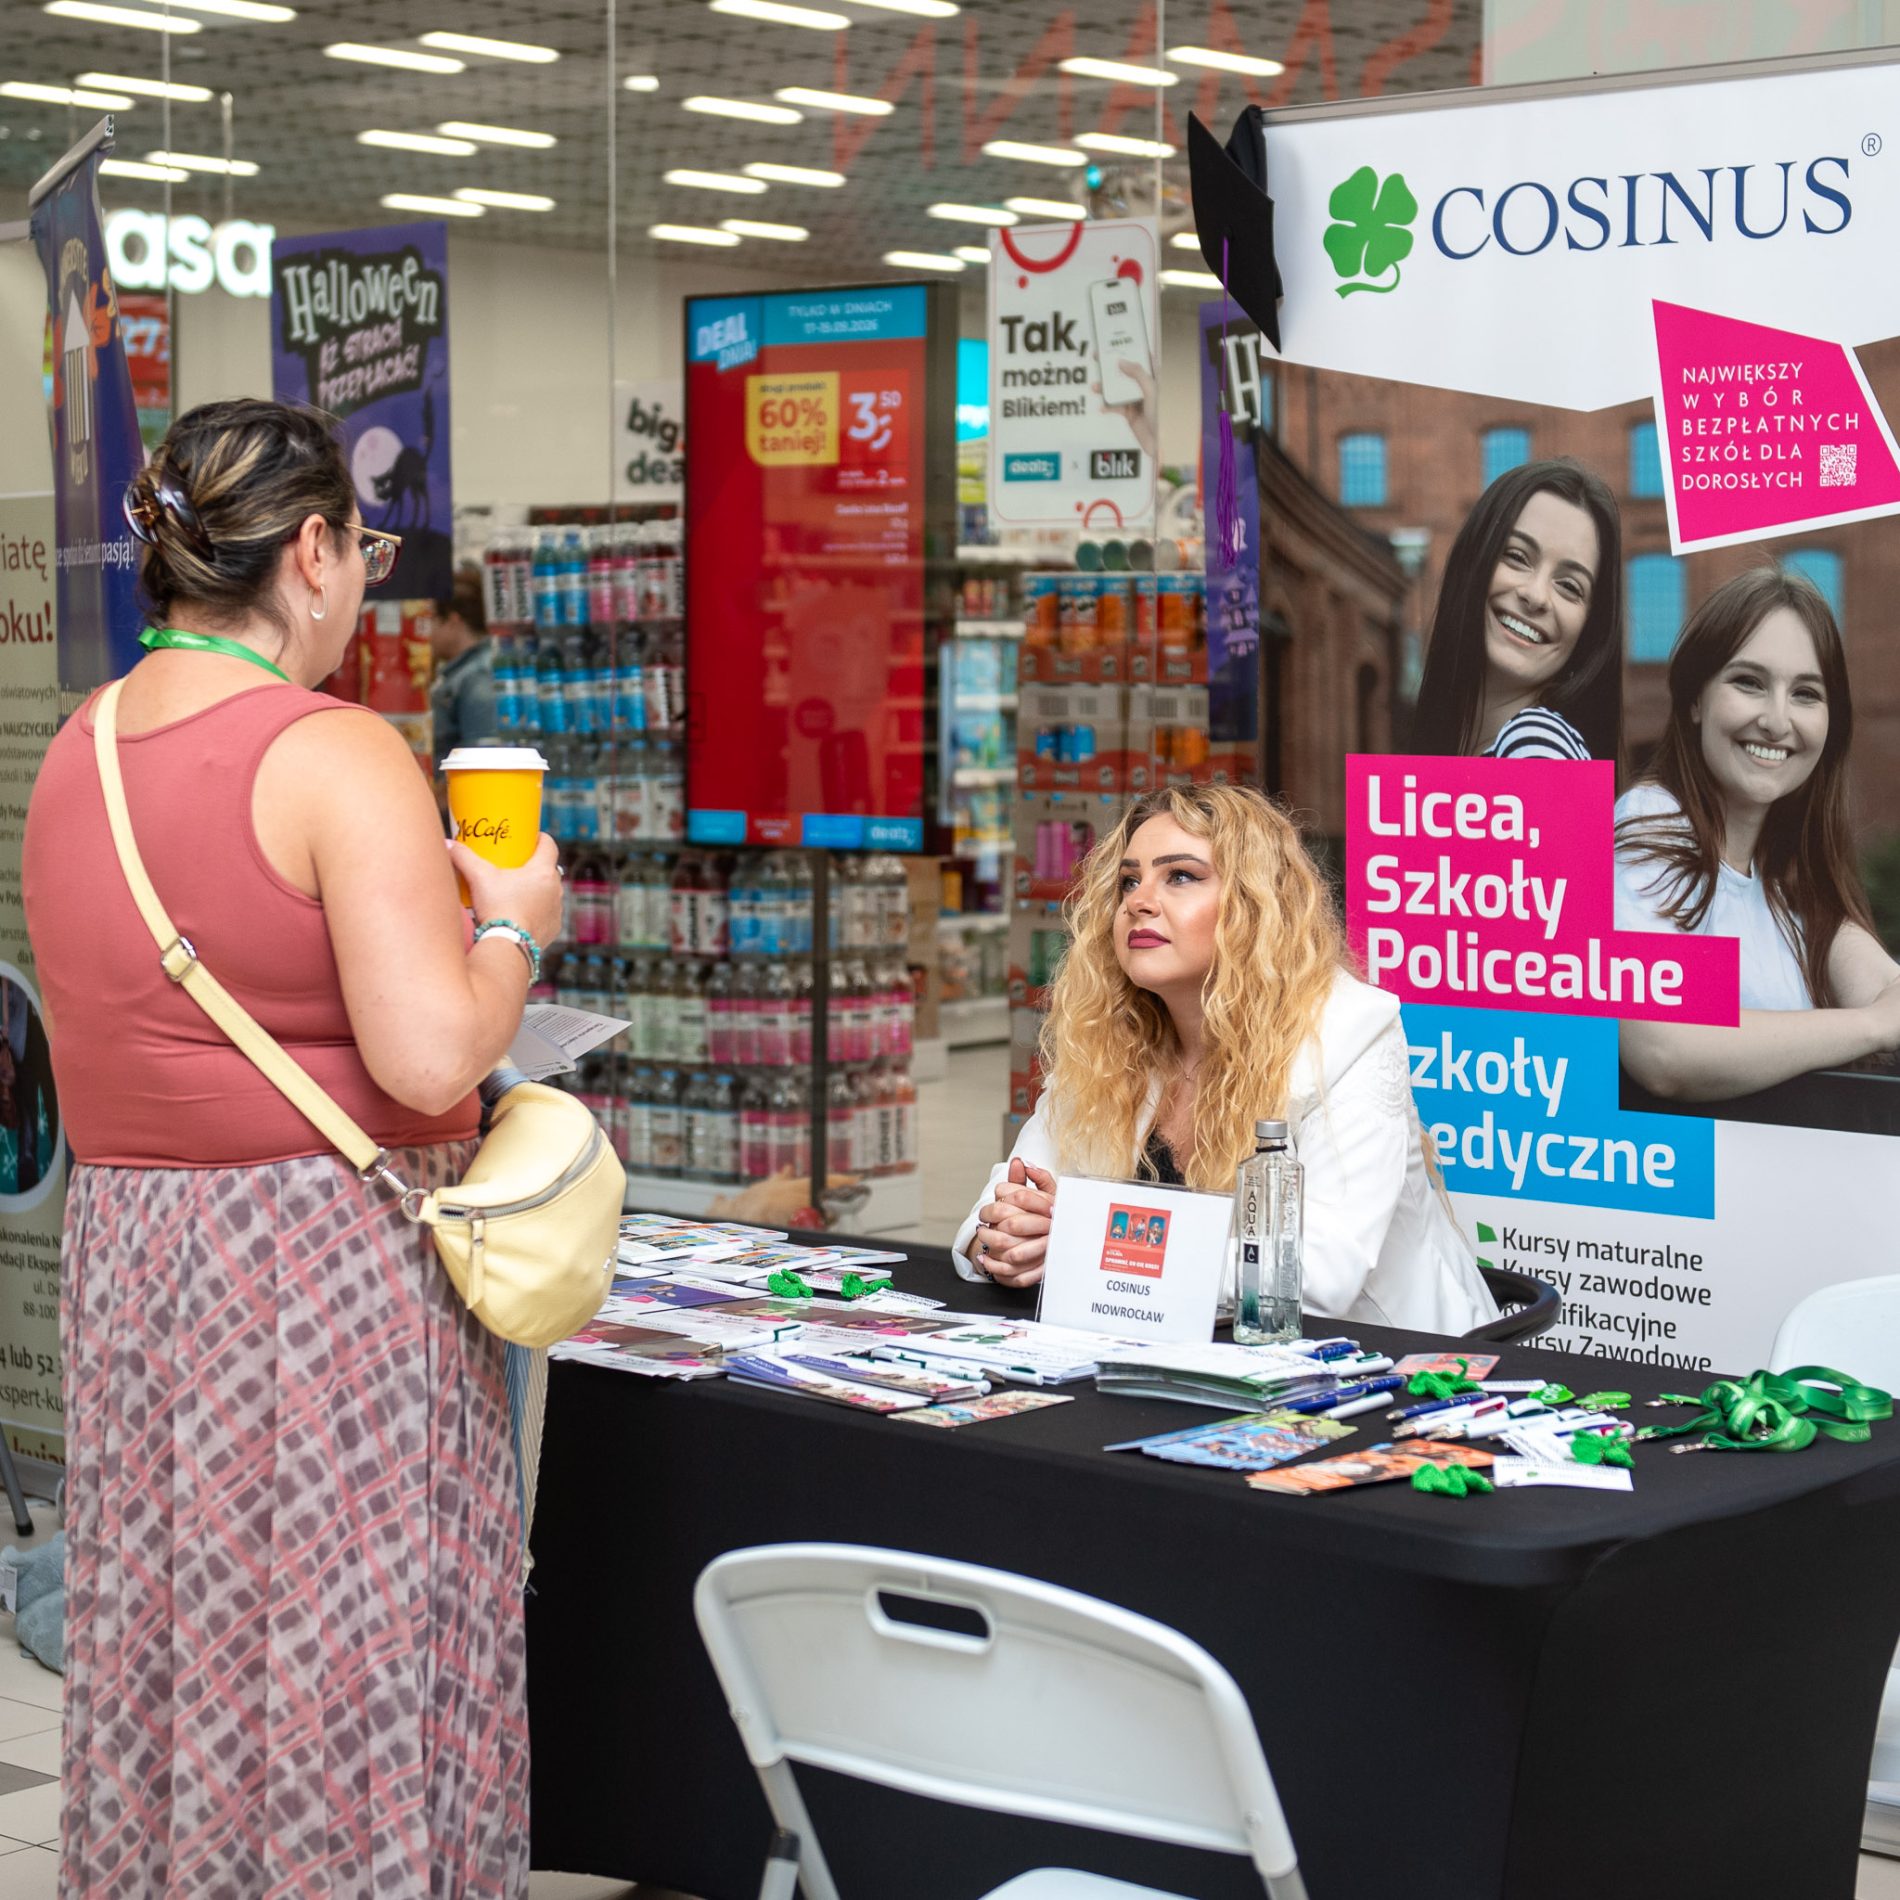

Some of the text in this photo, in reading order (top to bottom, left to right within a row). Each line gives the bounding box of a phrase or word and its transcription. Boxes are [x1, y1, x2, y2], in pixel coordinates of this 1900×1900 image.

[1431, 156, 1853, 260] COSINUS
[103, 208, 276, 298] asa
[283, 256, 438, 344] Halloween
[697, 312, 748, 357] DEAL
[1000, 311, 1089, 357] Tak,
[1001, 362, 1088, 387] można
[1682, 361, 1804, 386] NAJWIĘKSZY
[759, 397, 828, 430] 60%
[1001, 395, 1087, 418] Blikiem!
[1682, 412, 1860, 437] BEZPŁATNYCH
[626, 450, 686, 485] dea
[1096, 451, 1135, 477] blik
[1682, 440, 1804, 463] SZKÓŁ DLA
[1682, 471, 1804, 491] DOROSŁYCH
[101, 535, 135, 571] pasją!
[1367, 774, 1541, 849] Licea,
[1366, 855, 1568, 941] Szkoły
[1367, 927, 1684, 1006] Policealne
[1408, 1031, 1568, 1117] zkoły
[1428, 1110, 1676, 1190] edyczne
[1246, 1190, 1258, 1237] AQUA
[1502, 1227, 1704, 1272] Kursy maturalne
[1106, 1279, 1151, 1297] COSINUS
[1579, 1275, 1712, 1305] zawodowe
[23, 1303, 57, 1321] 88-100
[1091, 1301, 1165, 1324] INOWROCŁAW
[1503, 1302, 1677, 1342] ifikacyjne
[10, 1344, 34, 1371] lub
[37, 1357, 55, 1378] 52
[1579, 1335, 1712, 1373] Zawodowe
